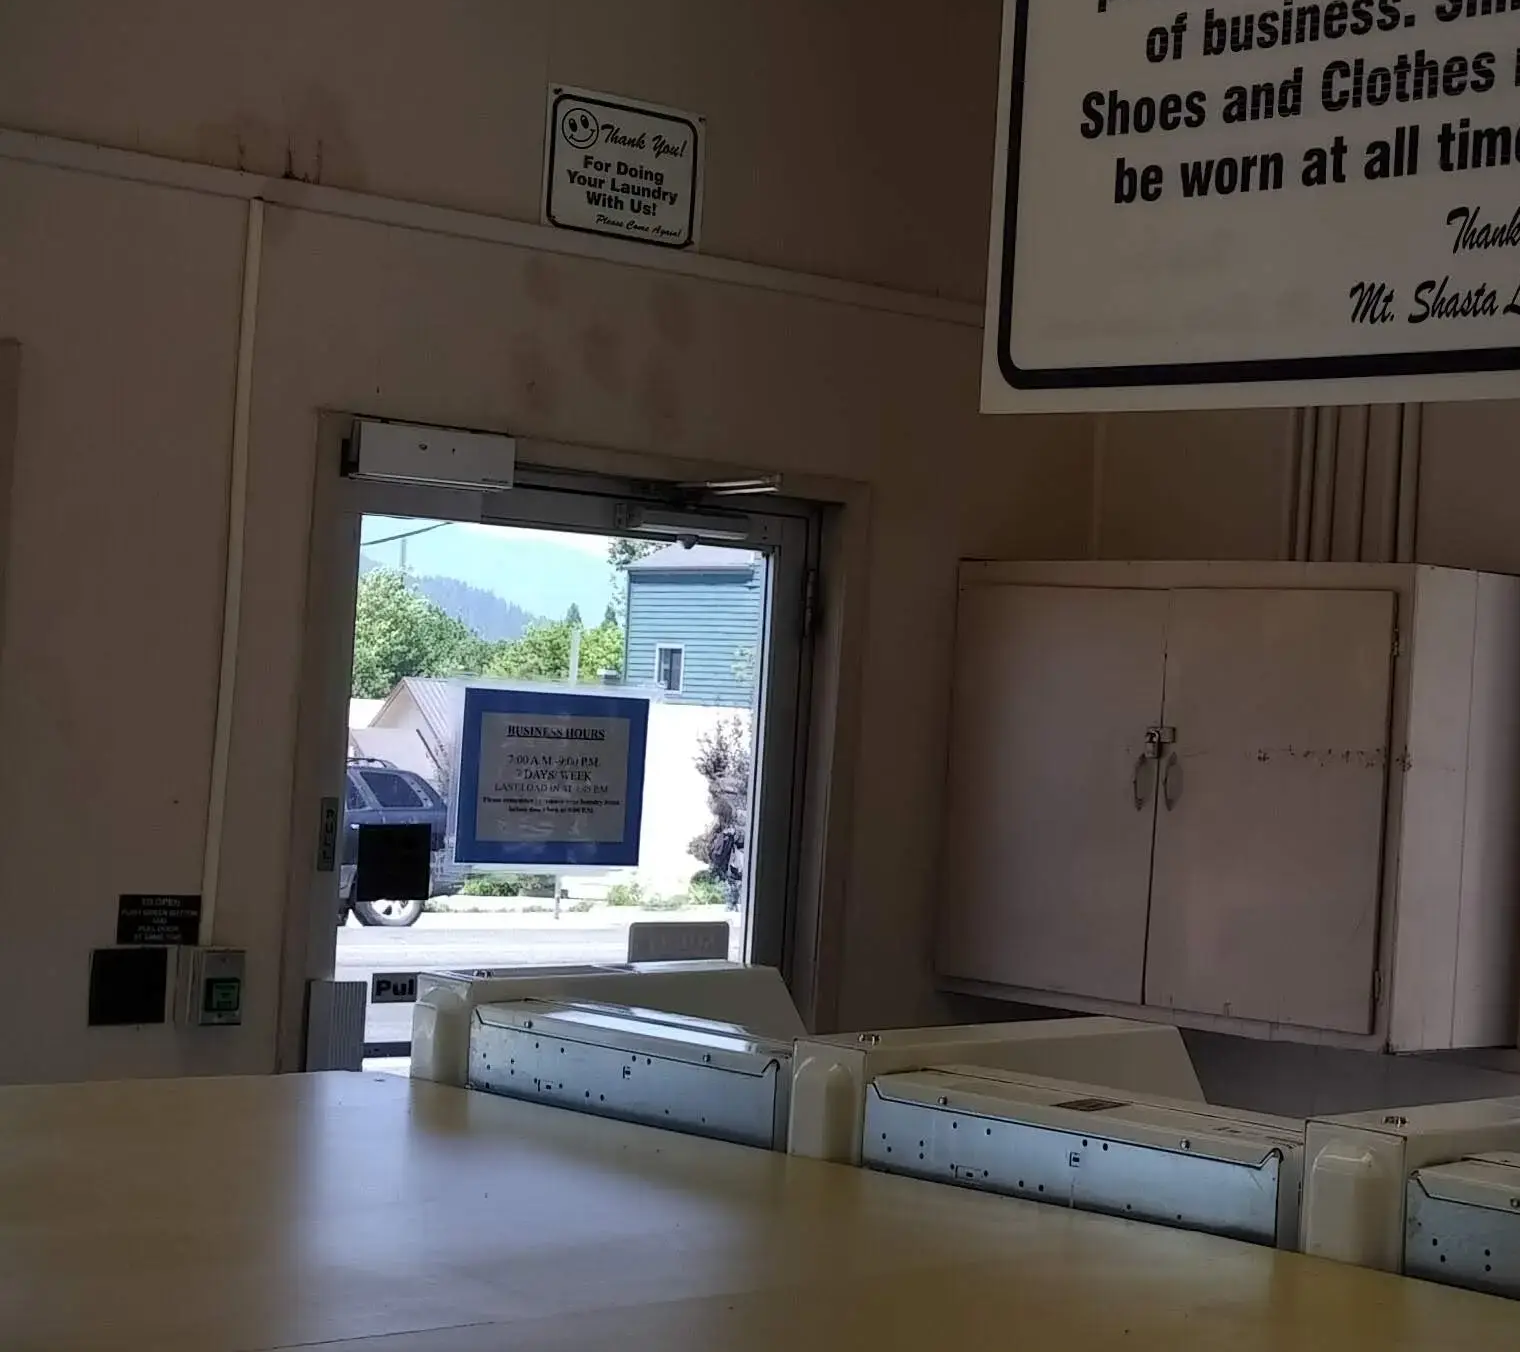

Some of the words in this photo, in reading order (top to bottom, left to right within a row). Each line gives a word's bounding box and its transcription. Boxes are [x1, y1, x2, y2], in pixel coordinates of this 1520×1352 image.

[1145, 11, 1187, 63] of
[1080, 89, 1207, 139] Shoes
[1223, 67, 1303, 124] and
[1320, 48, 1496, 111] Clothes
[601, 124, 646, 150] Thank
[652, 134, 687, 159] You!
[583, 155, 612, 173] For
[616, 161, 664, 186] Doing
[1114, 157, 1163, 204] be
[1180, 144, 1283, 197] worn
[1301, 135, 1348, 186] at
[1363, 125, 1420, 180] all
[567, 169, 606, 189] Your
[610, 178, 678, 205] Laundry
[586, 191, 624, 210] With
[630, 199, 657, 216] Us!
[596, 214, 623, 227] Please
[626, 219, 650, 231] Come
[1349, 280, 1395, 324] Mt.
[1407, 275, 1499, 324] Shasta
[507, 725, 562, 738] BUSINESS
[565, 727, 605, 740] HOURS
[376, 979, 414, 996] Pul
